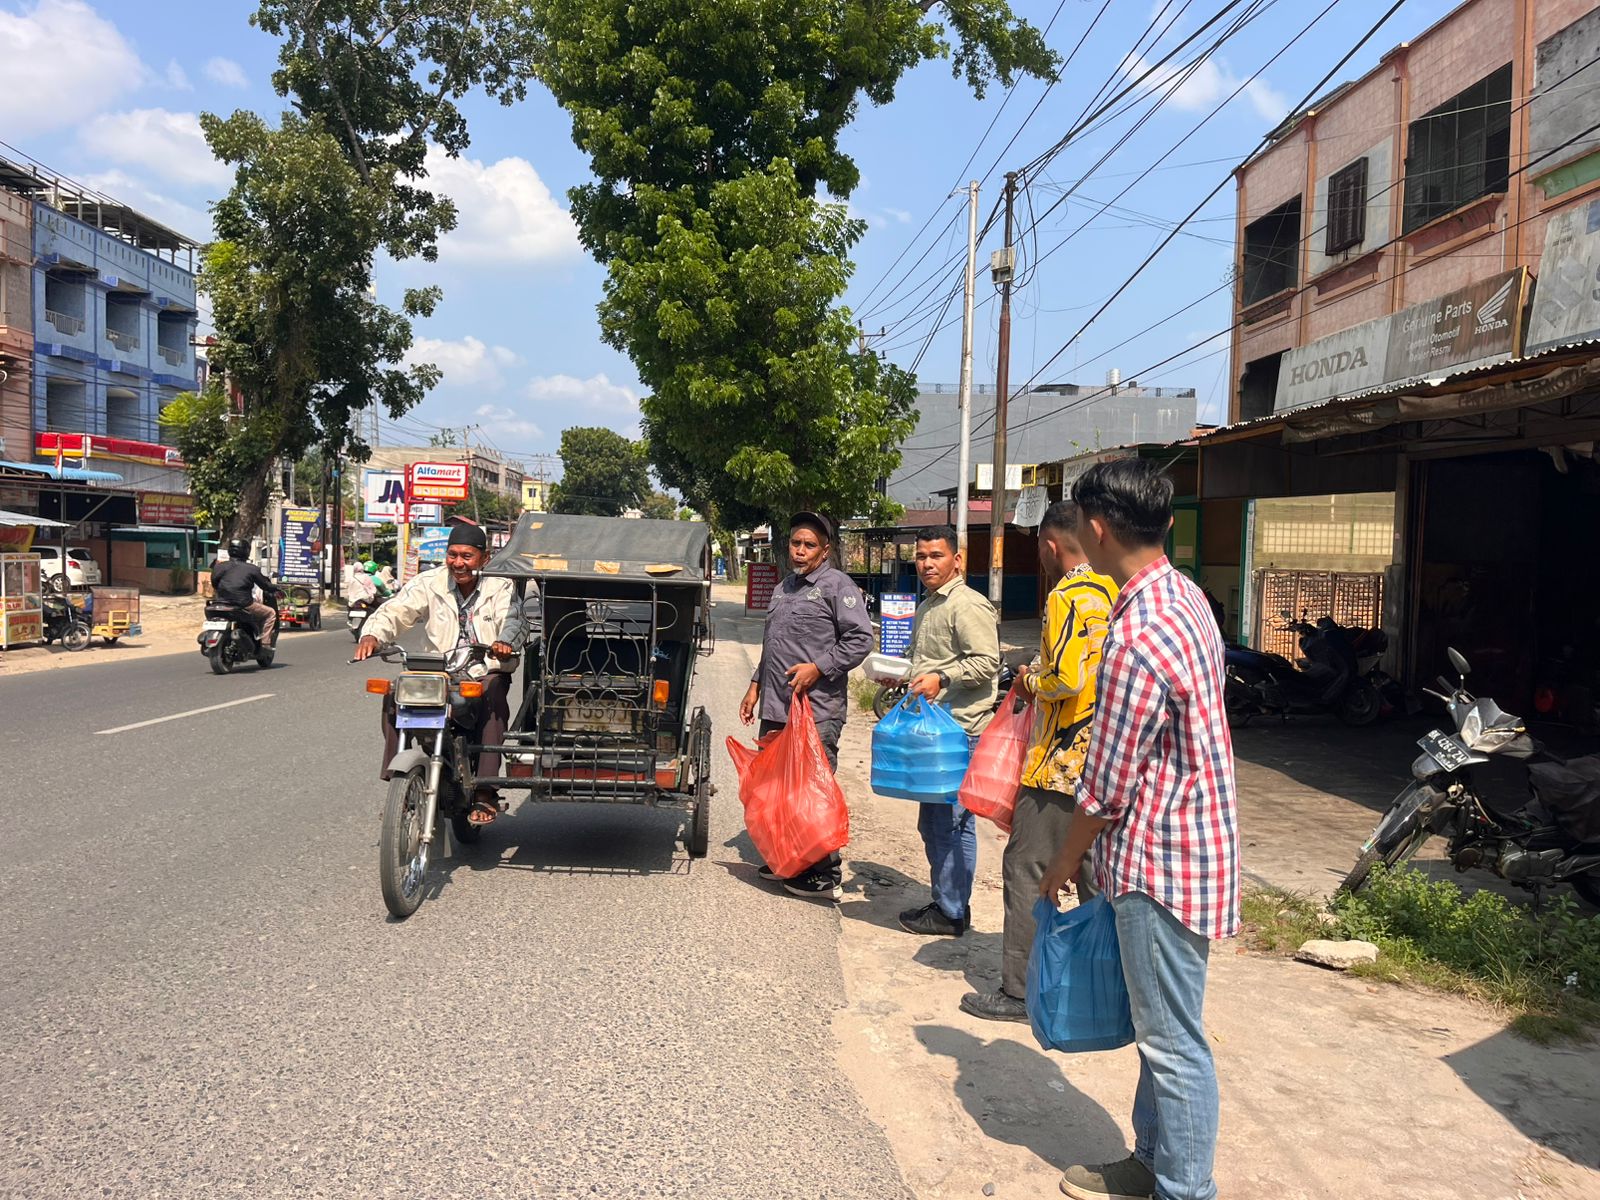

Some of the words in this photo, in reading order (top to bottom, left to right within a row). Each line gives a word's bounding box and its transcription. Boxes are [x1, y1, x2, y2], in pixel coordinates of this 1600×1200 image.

[1445, 300, 1473, 320] Parts
[1474, 318, 1509, 335] HONDA
[1289, 346, 1369, 387] HONDA
[416, 466, 462, 477] Alfamart
[377, 479, 424, 505] JN
